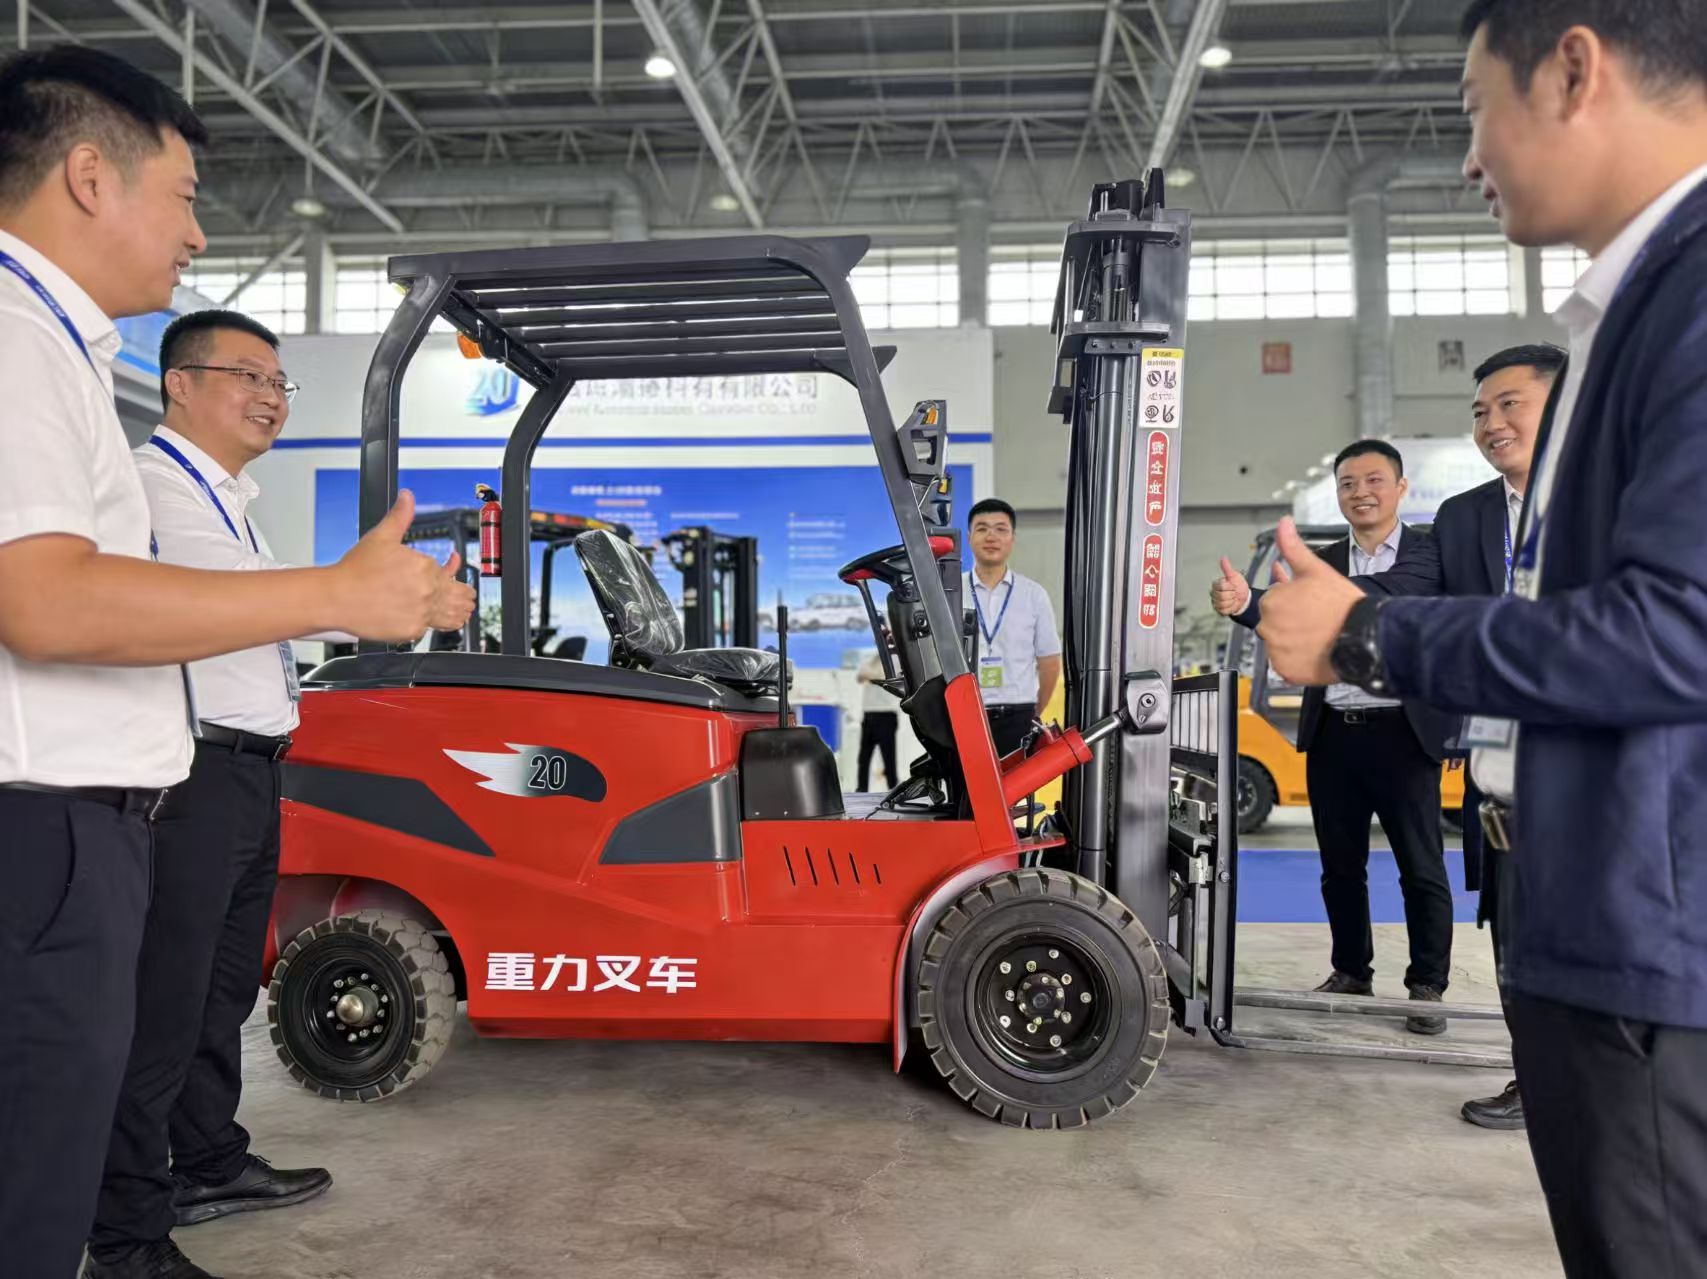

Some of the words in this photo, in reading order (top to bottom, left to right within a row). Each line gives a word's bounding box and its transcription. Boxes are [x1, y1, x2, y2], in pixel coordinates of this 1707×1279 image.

[528, 754, 567, 791] 20
[484, 952, 698, 994] 重力叉车
